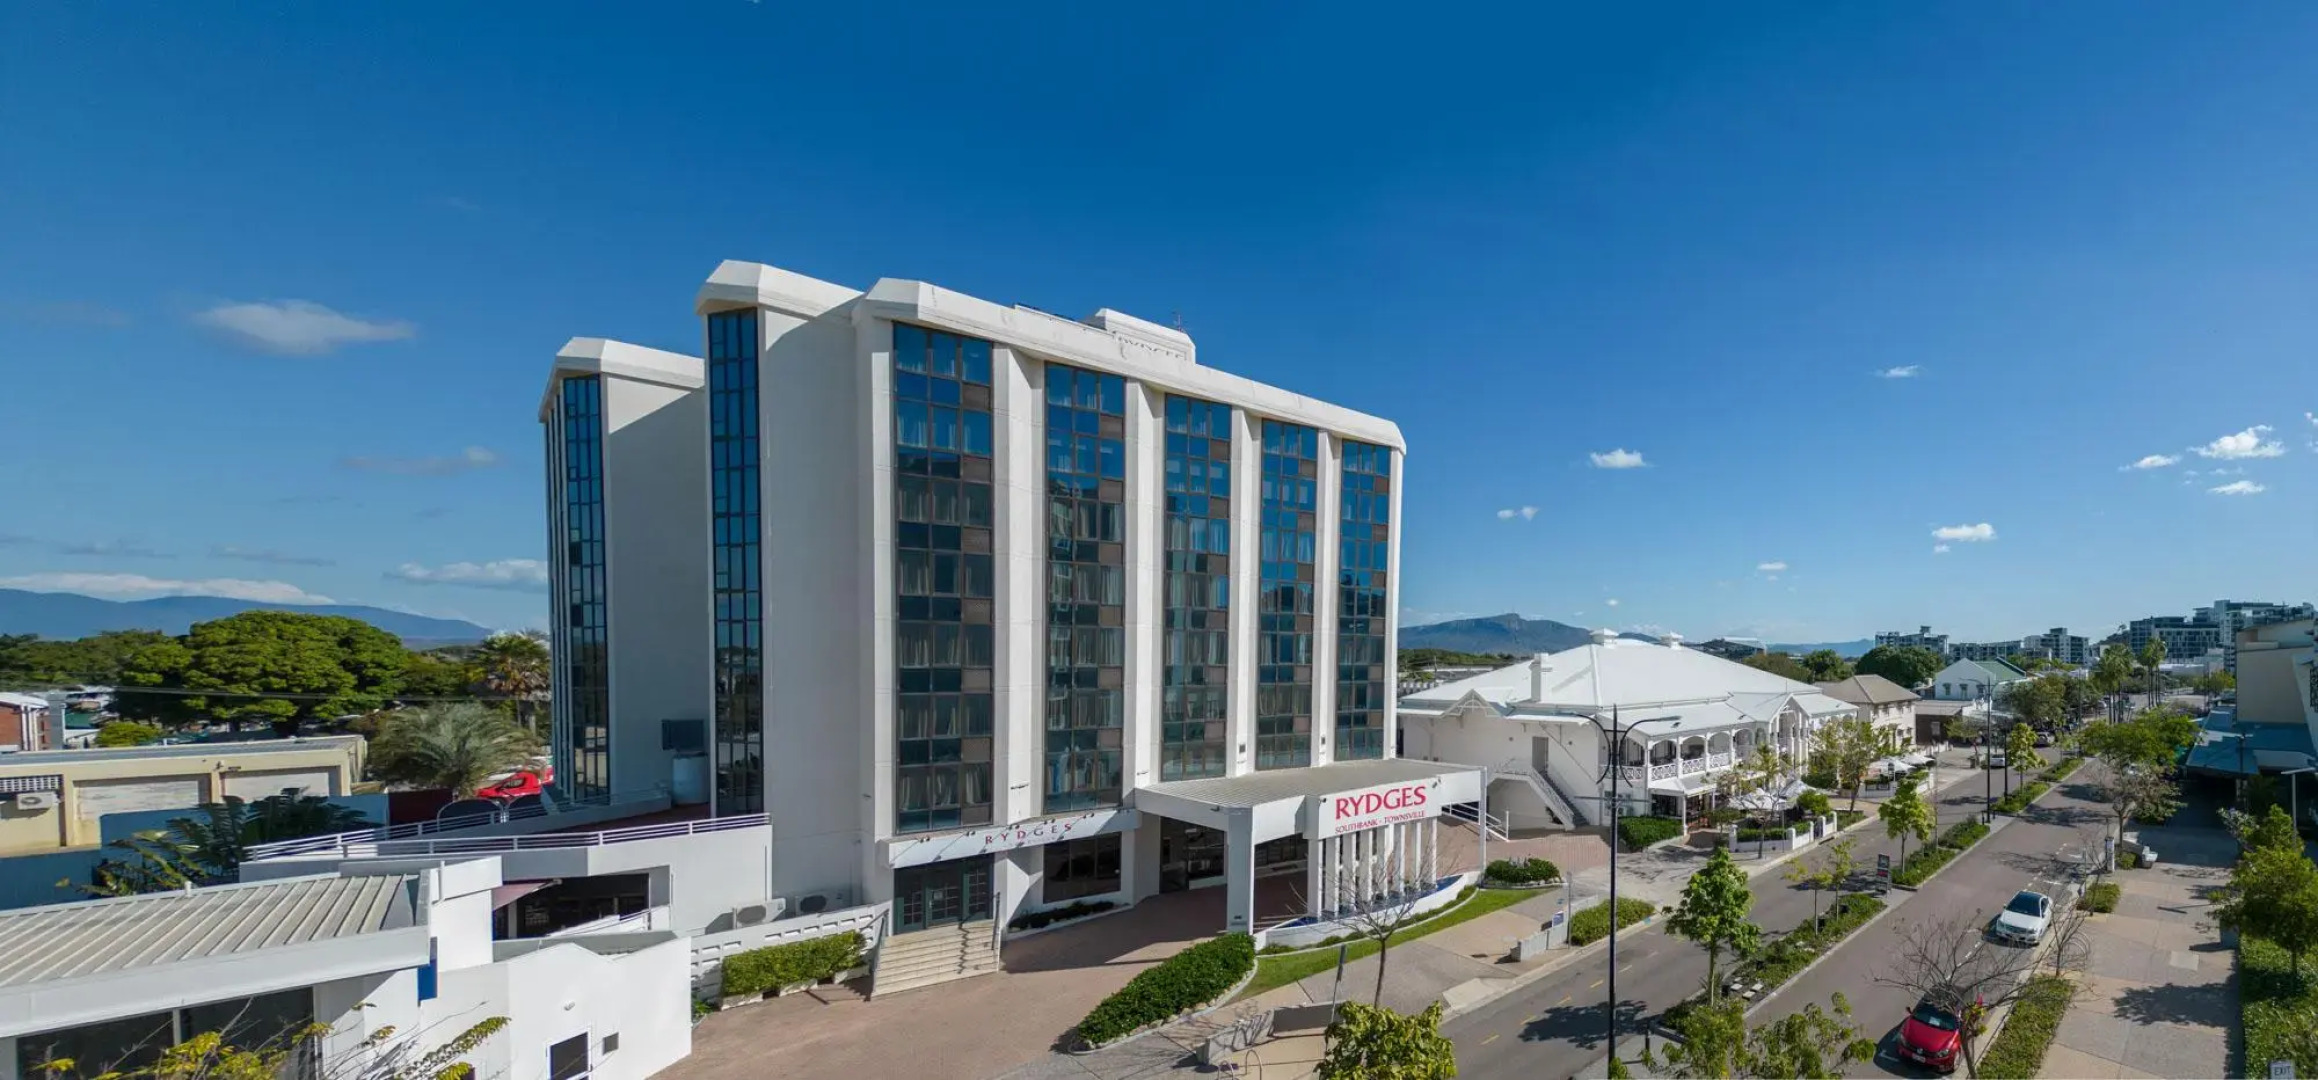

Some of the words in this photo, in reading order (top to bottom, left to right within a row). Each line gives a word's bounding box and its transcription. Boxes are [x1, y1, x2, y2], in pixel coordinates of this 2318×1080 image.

[1336, 786, 1426, 819] RYDGES
[985, 823, 1072, 845] RYDGES
[1335, 819, 1378, 834] SOUTHBANK
[1384, 810, 1425, 824] TOWNSVILLE
